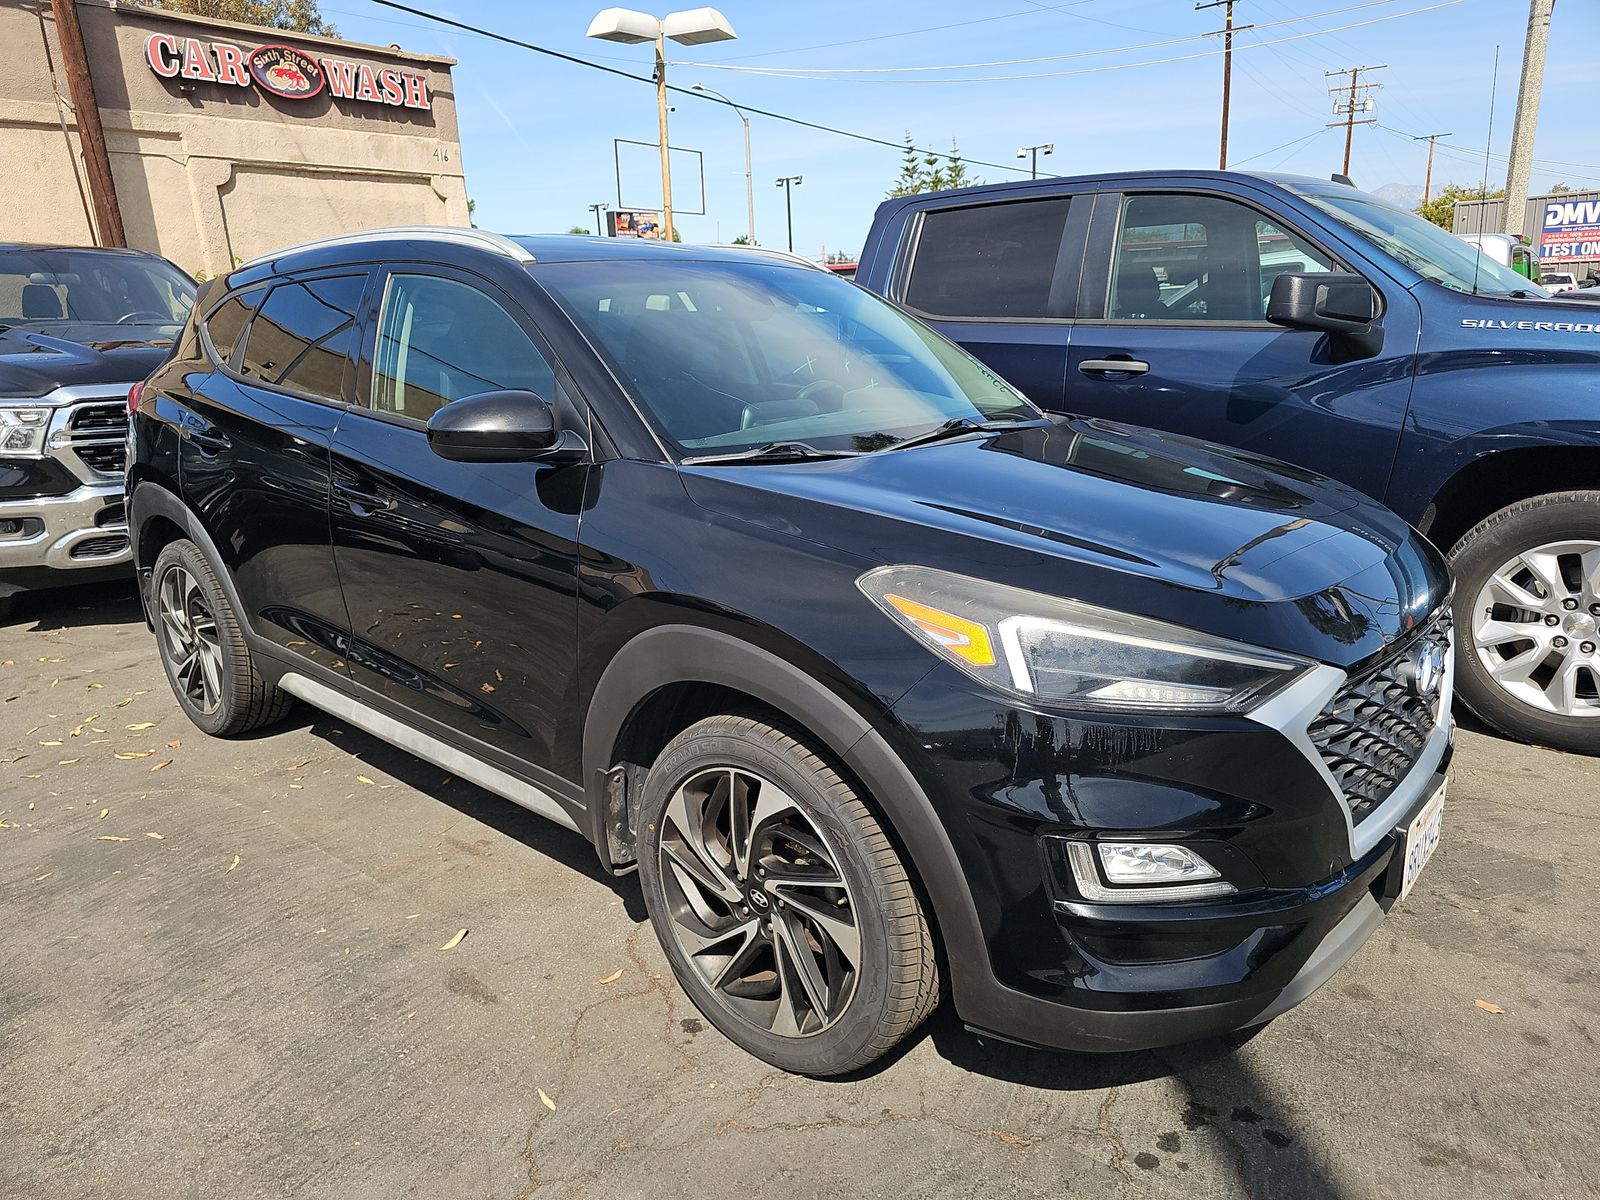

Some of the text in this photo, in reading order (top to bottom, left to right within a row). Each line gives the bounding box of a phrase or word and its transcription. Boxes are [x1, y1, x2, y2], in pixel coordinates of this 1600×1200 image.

[145, 33, 431, 110] CAR WASH
[253, 50, 319, 77] Sixth Street
[432, 148, 449, 162] 416
[1546, 202, 1600, 225] DMV
[1543, 241, 1600, 257] TEST ON
